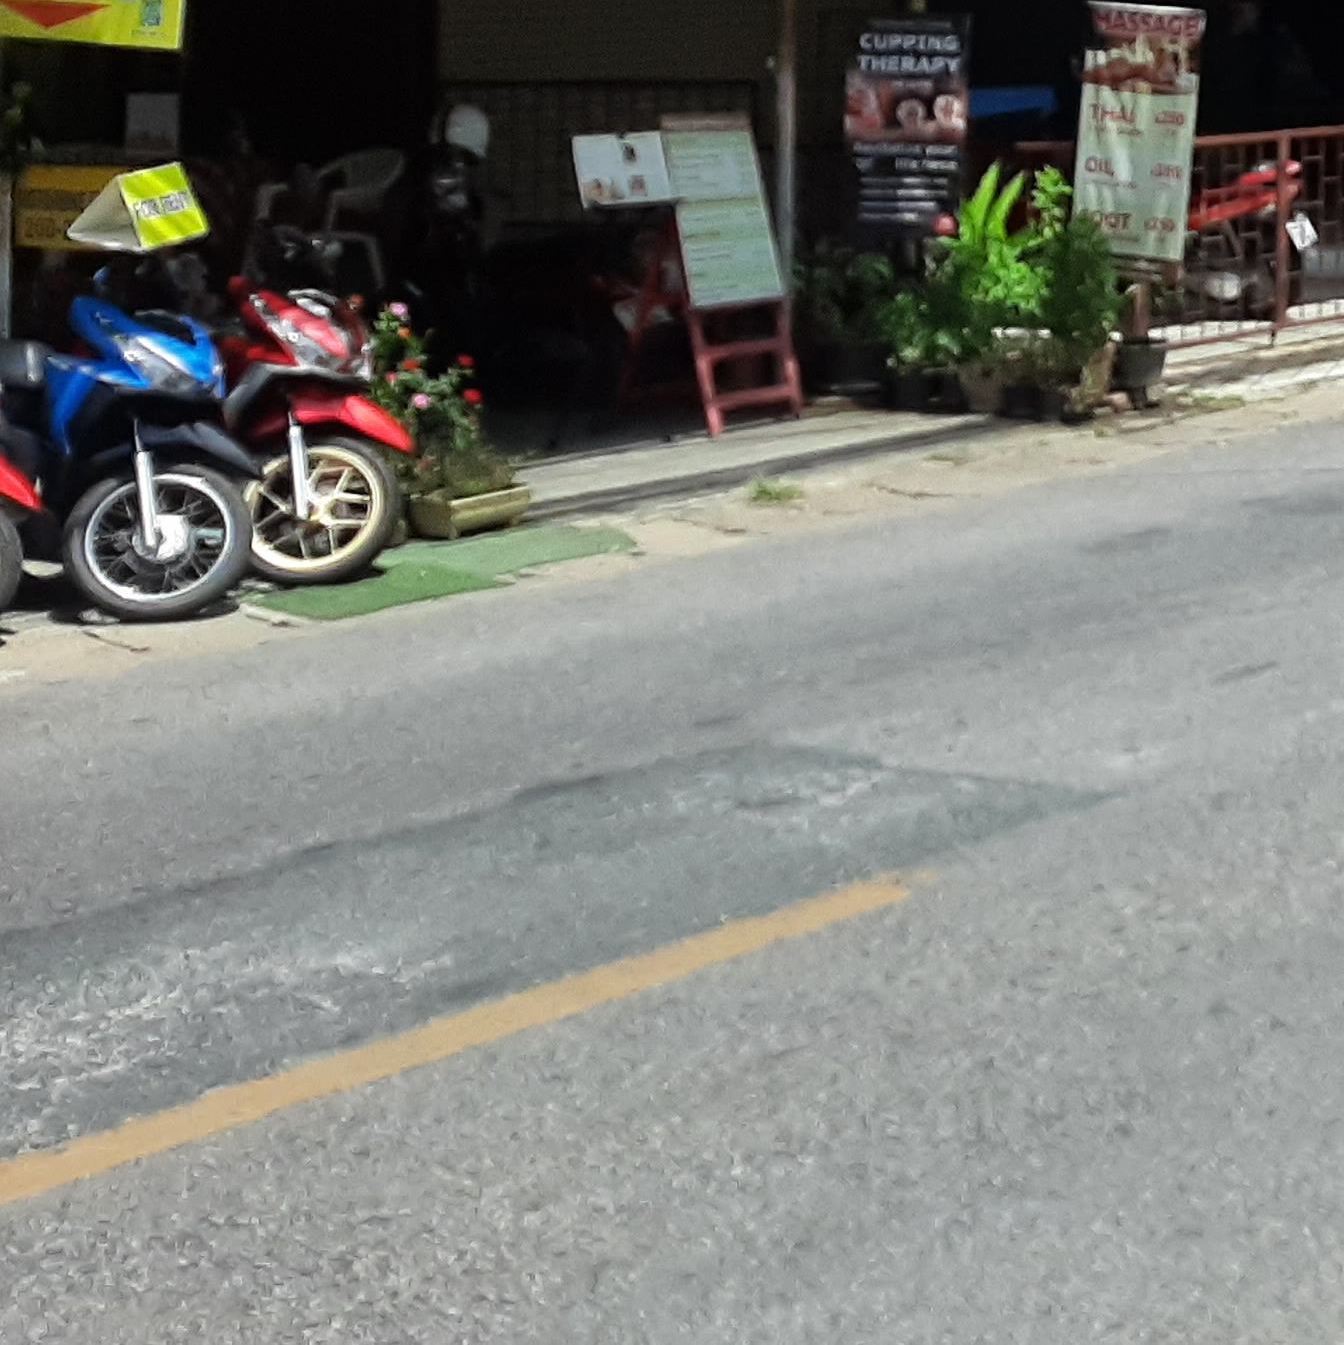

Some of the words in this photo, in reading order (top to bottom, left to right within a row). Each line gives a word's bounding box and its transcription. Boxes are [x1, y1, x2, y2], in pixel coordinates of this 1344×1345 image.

[1095, 10, 1199, 38] MASSAGE
[858, 33, 961, 53] CUPPING
[858, 55, 961, 73] THERAPY
